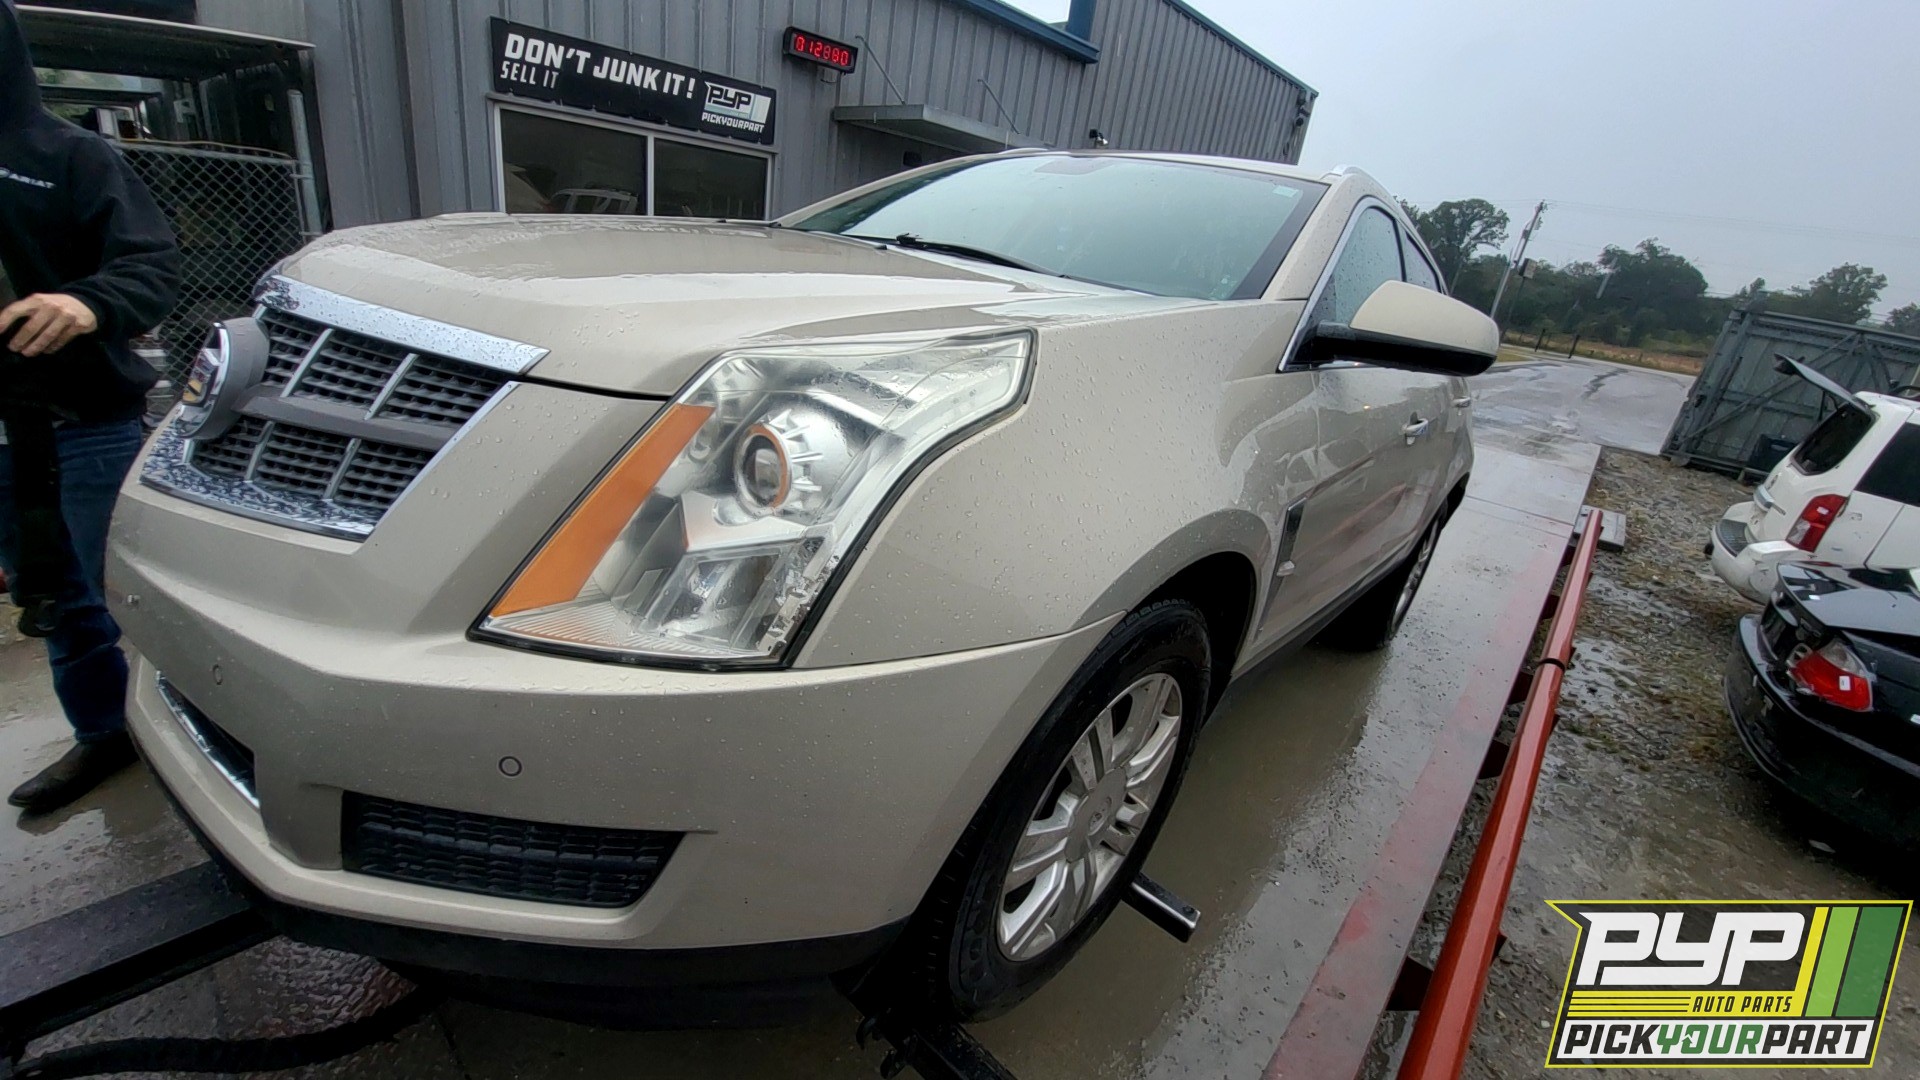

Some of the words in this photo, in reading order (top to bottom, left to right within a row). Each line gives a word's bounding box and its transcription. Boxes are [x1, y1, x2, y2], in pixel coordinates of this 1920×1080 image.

[500, 60, 536, 85] SELL
[543, 69, 559, 89] IT
[505, 33, 591, 74] DON'T
[593, 56, 661, 91] JUNK
[707, 85, 751, 110] PYP
[702, 111, 765, 133] PICKYOURPART
